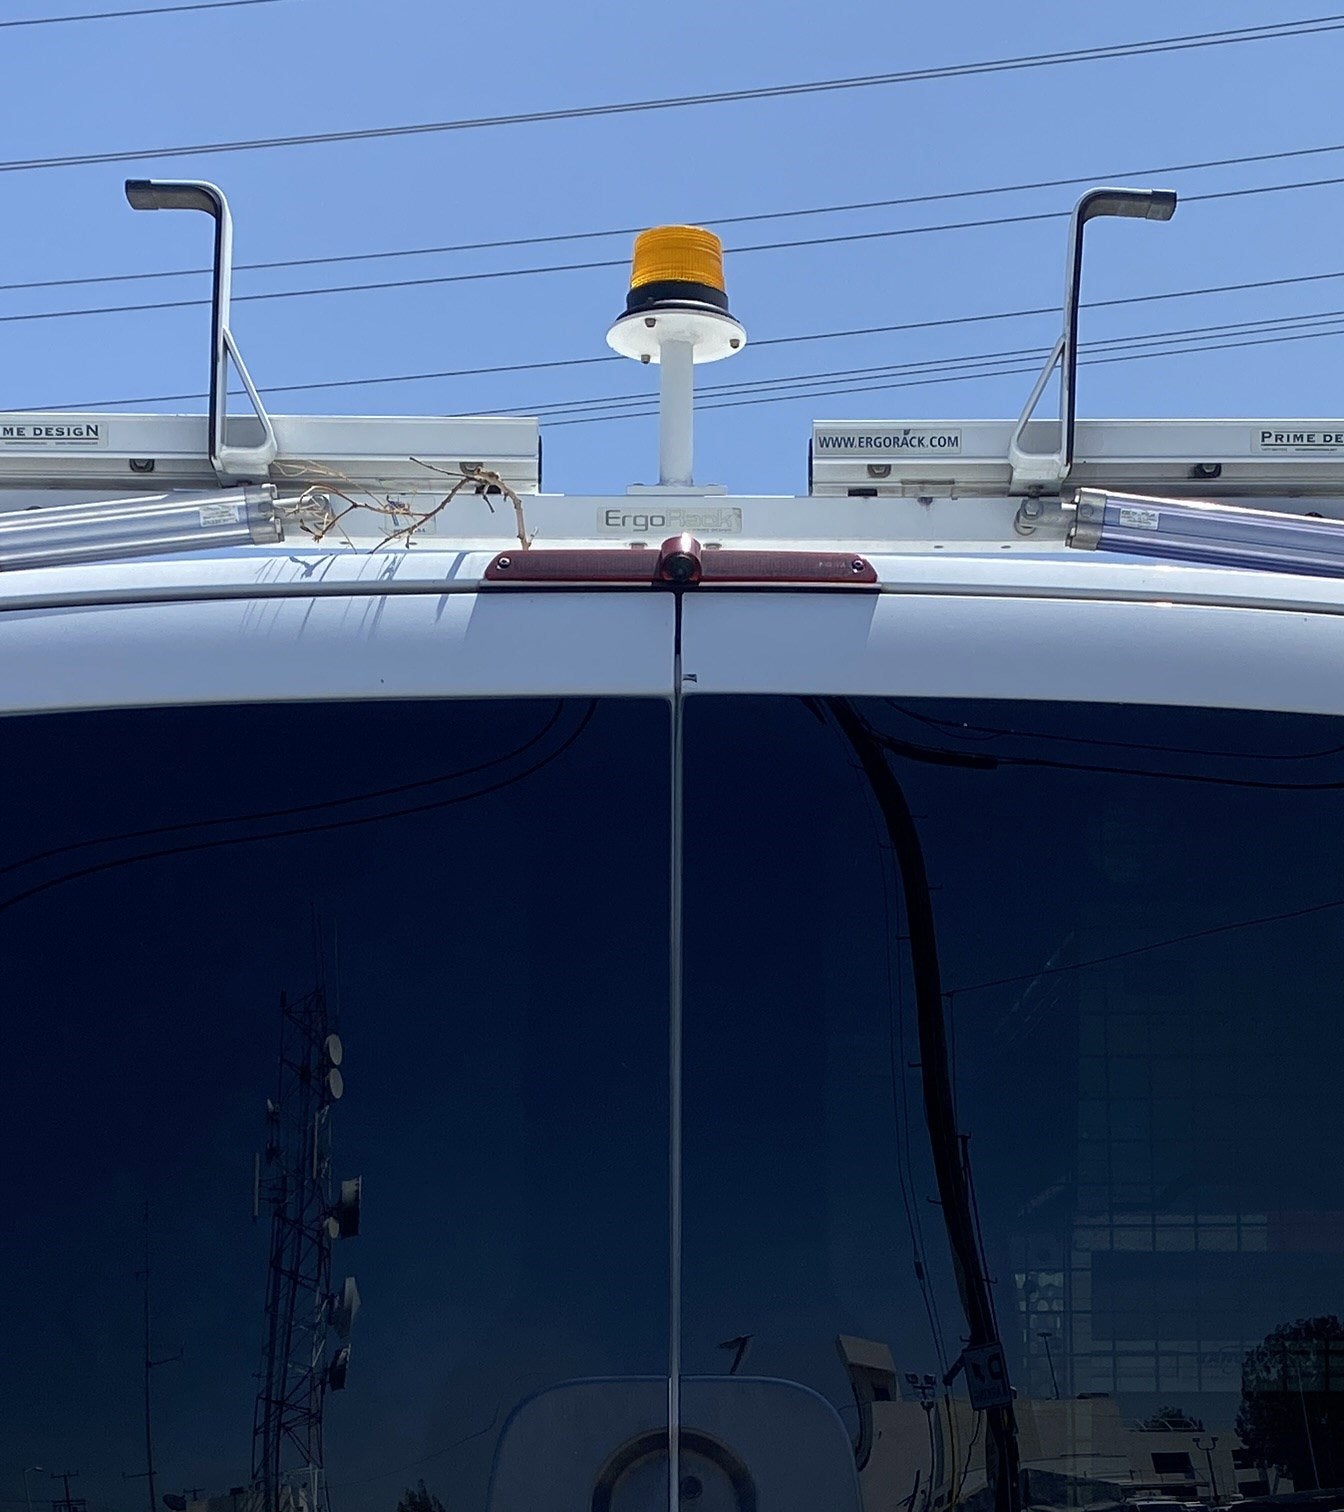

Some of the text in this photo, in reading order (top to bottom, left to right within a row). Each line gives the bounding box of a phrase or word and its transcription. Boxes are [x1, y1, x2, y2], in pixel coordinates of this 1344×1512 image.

[33, 424, 99, 437] DESIGN
[1260, 431, 1316, 443] PRIME
[818, 435, 959, 449] WWW.ERGORACK.COM
